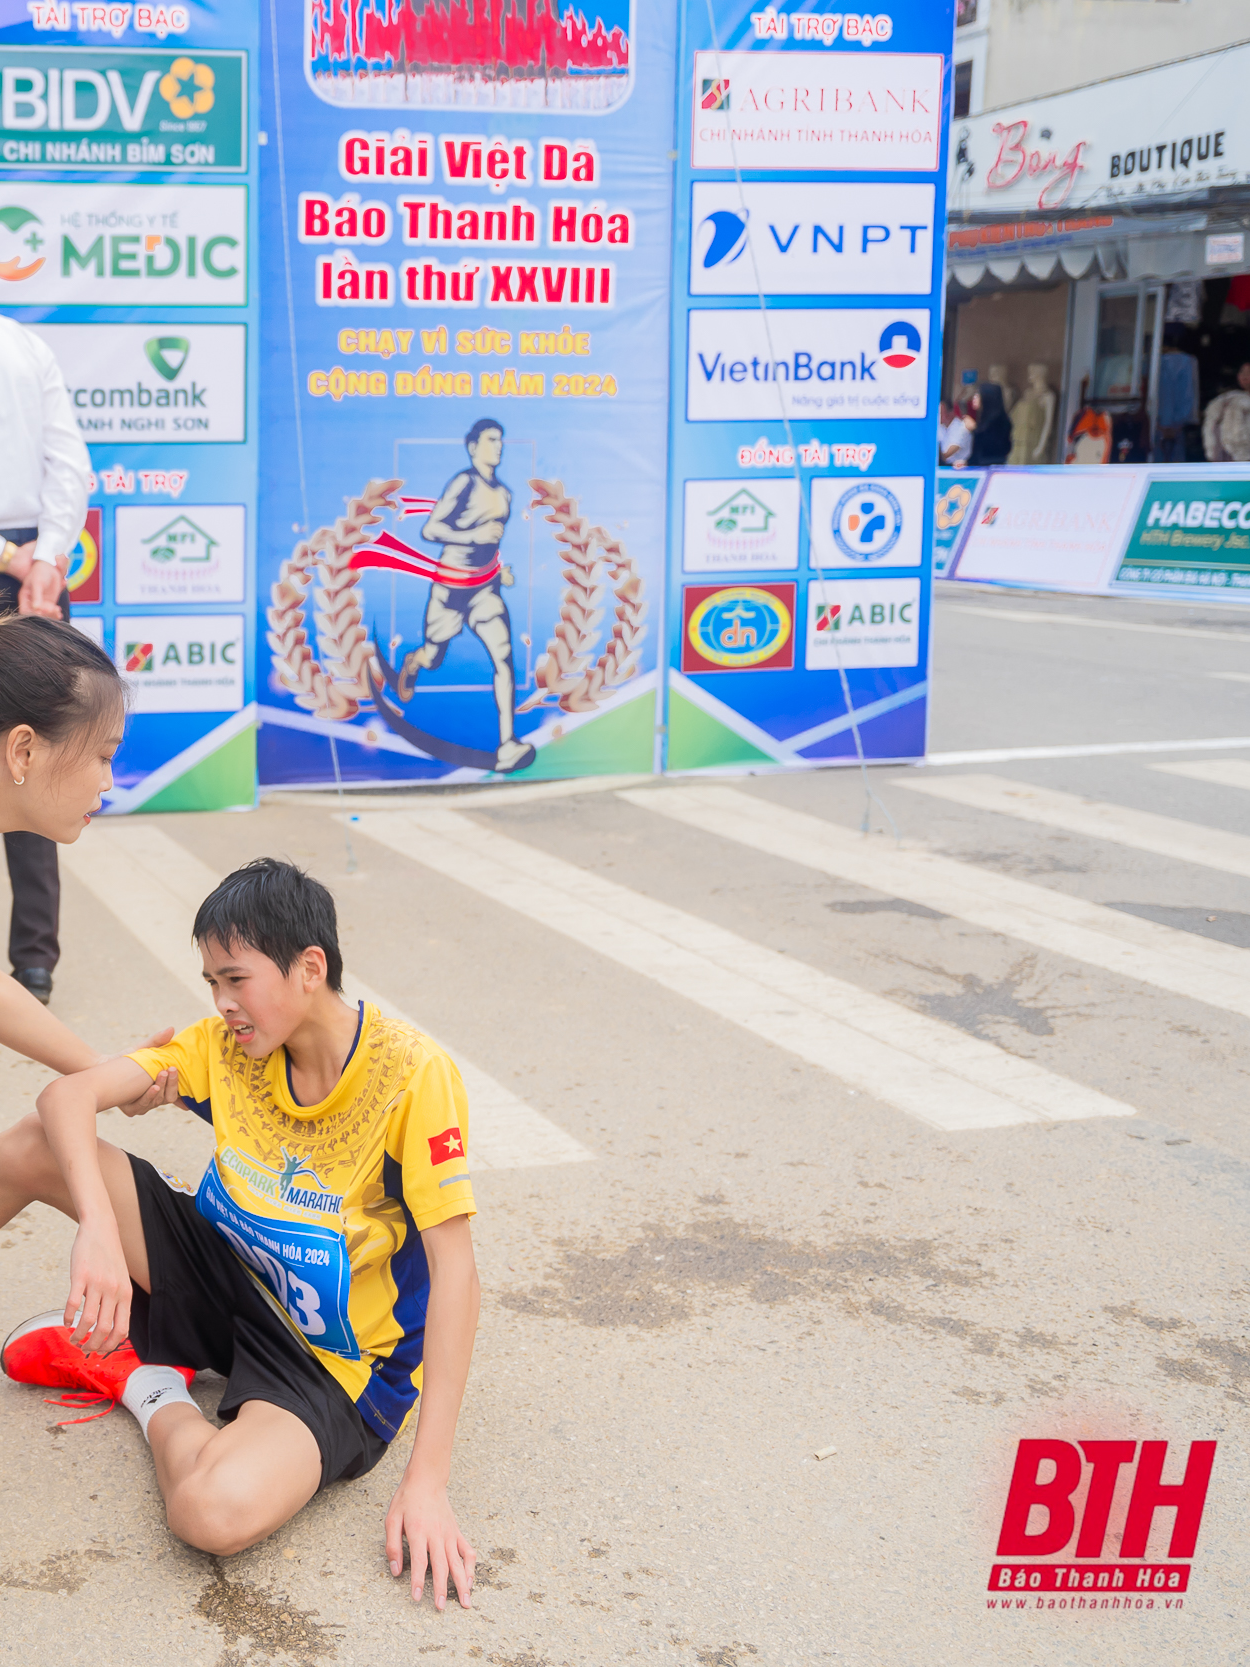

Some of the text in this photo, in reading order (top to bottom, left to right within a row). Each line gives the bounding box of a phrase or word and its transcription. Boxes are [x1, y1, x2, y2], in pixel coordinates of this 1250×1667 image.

[77, 7, 129, 33] TRỢ
[138, 8, 185, 34] BẠC
[753, 12, 889, 43] TÀI TRỢ BẠC
[2, 66, 161, 132] BIDV
[740, 87, 932, 113] AGRIBANK
[699, 128, 726, 142] CHI
[731, 125, 790, 142] NHÁNH
[839, 129, 894, 142] THANH
[899, 126, 932, 143] HÓA
[3, 136, 215, 165] CHI NHÁNH BỈM SƠN
[344, 135, 428, 177] Giải
[444, 141, 527, 187] Việt
[1110, 131, 1226, 178] BOUTIQUE
[304, 199, 630, 244] Báo Thanh Hóa
[768, 224, 928, 254] VNPT
[60, 234, 239, 279] MEDIC
[321, 255, 610, 304] lần thứ XXVIII
[339, 329, 414, 358] CHẠY
[421, 325, 447, 355] VÌ
[456, 327, 511, 355] SỨC
[698, 351, 877, 382] VietinBank
[308, 367, 387, 400] CỘNG
[480, 369, 544, 397] NĂM
[552, 373, 617, 397] 2024
[120, 418, 166, 431] NGHI
[802, 440, 828, 464] TÀI
[834, 448, 874, 468] TRỢ
[142, 473, 186, 495] TRỢ
[847, 603, 912, 626] ABIC
[162, 642, 236, 666] ABIC
[220, 1147, 280, 1197] ECOPARK
[254, 1230, 281, 1254] THANH
[283, 1242, 302, 1262] HÓA
[305, 1248, 330, 1267] 2024
